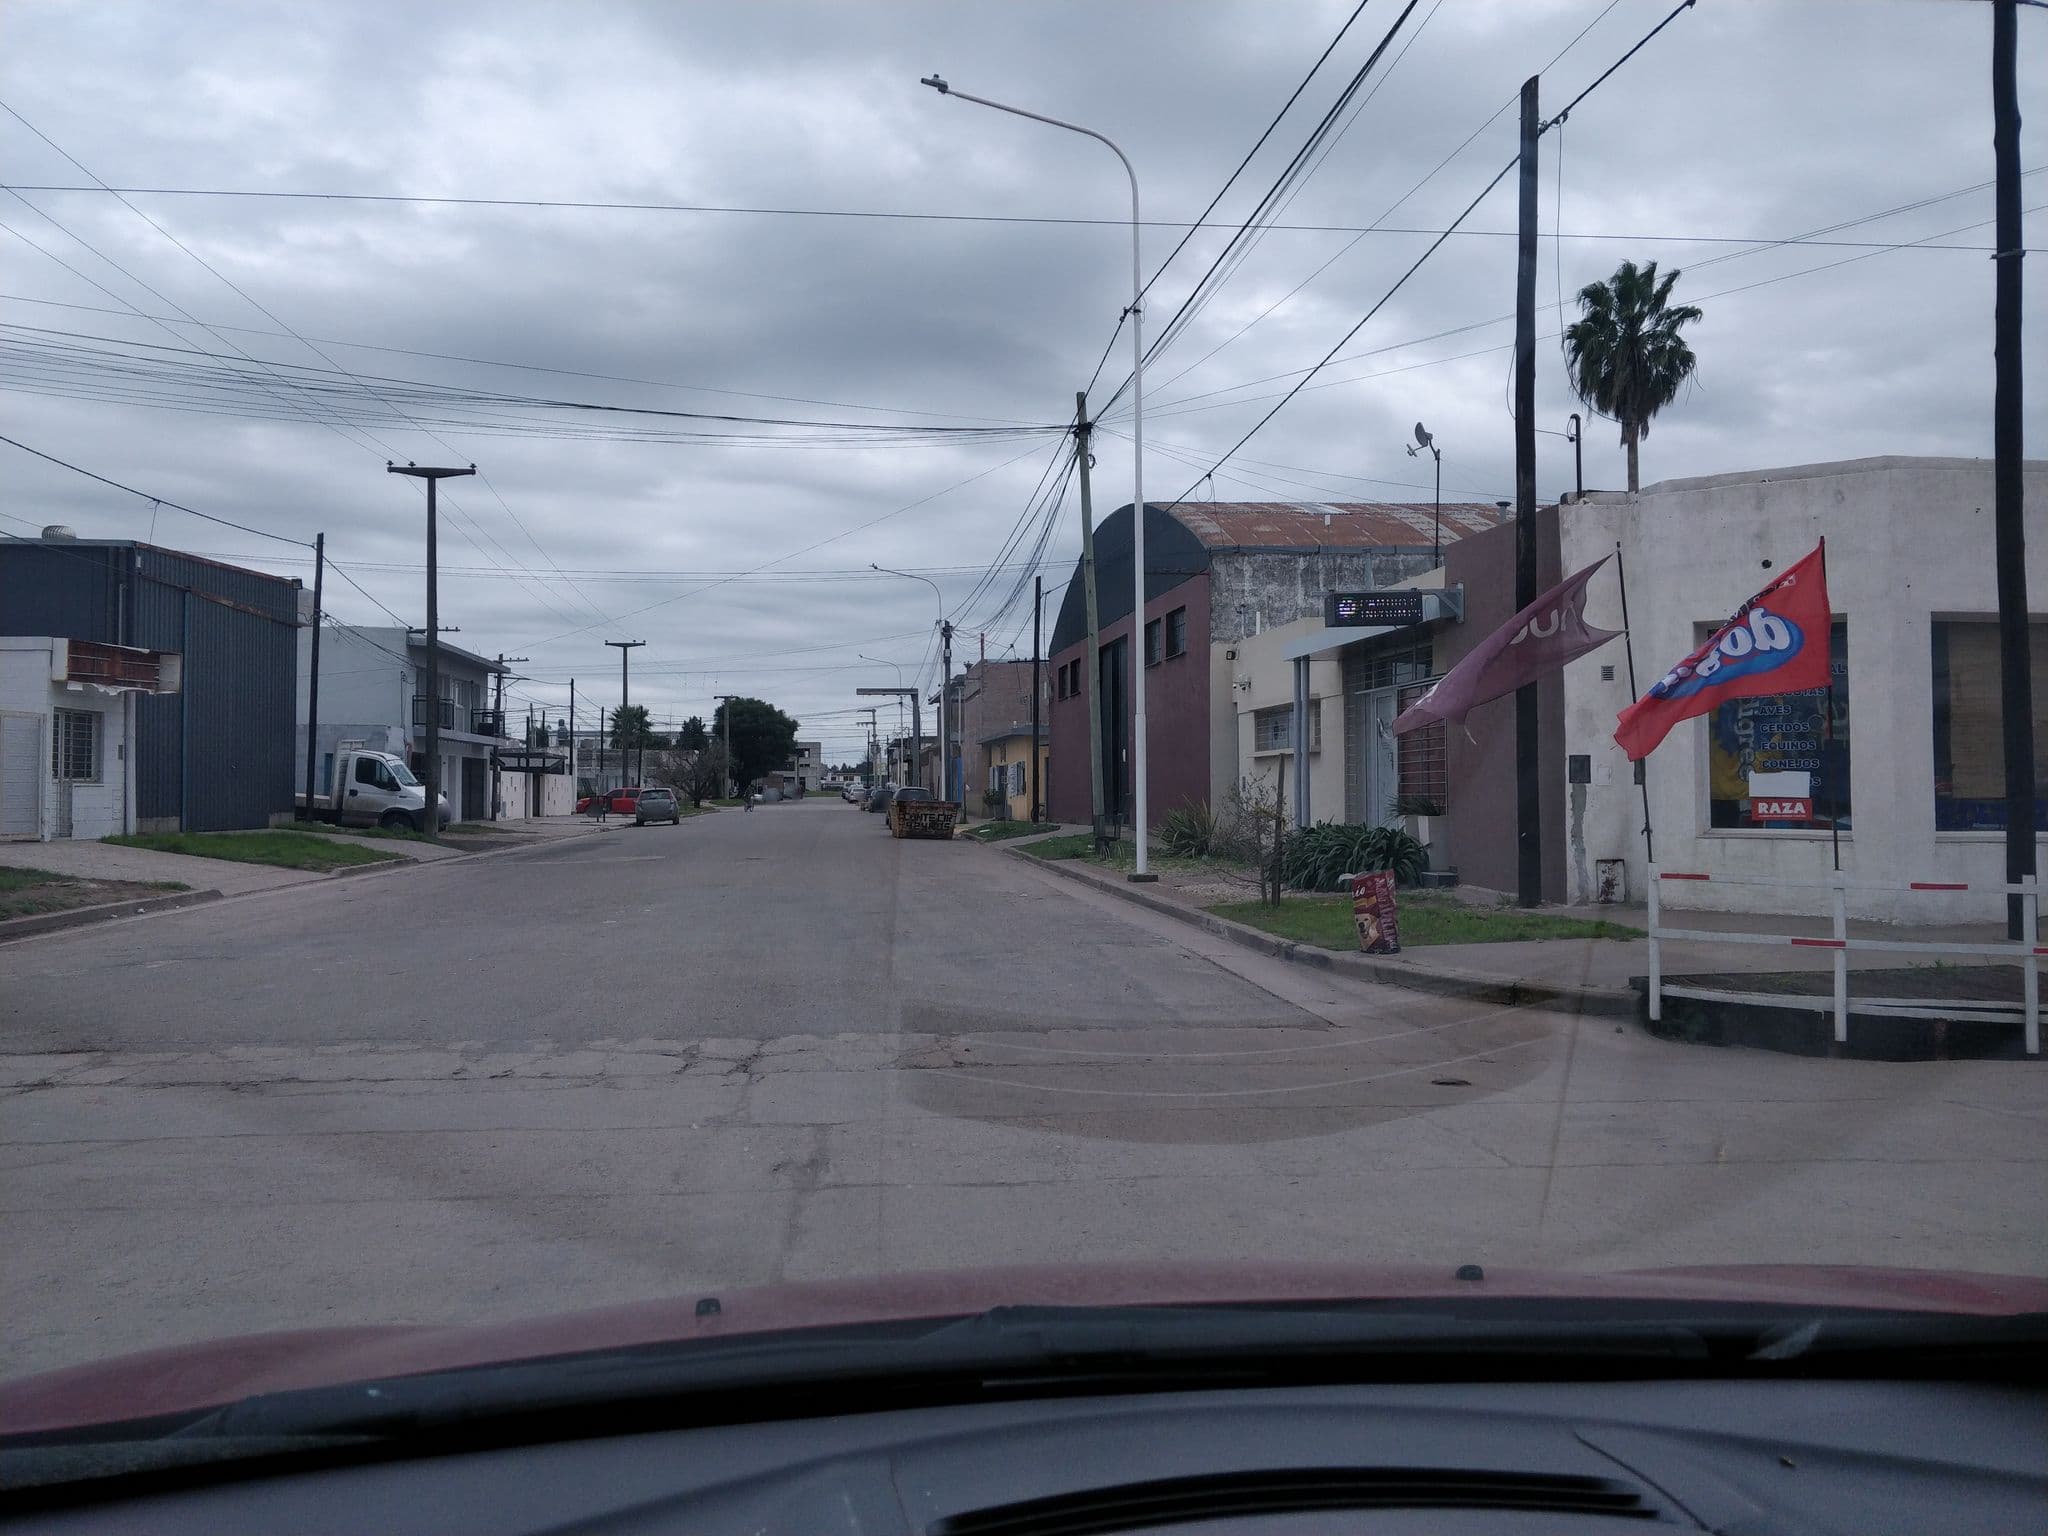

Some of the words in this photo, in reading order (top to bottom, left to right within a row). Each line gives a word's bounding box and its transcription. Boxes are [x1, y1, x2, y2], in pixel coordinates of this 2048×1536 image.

[1759, 704, 1793, 715] AVES
[1760, 722, 1810, 733] CERDOS
[1761, 740, 1817, 751] EQUINOS
[1762, 758, 1821, 769] CONEJOS
[1757, 802, 1806, 814] RAZA
